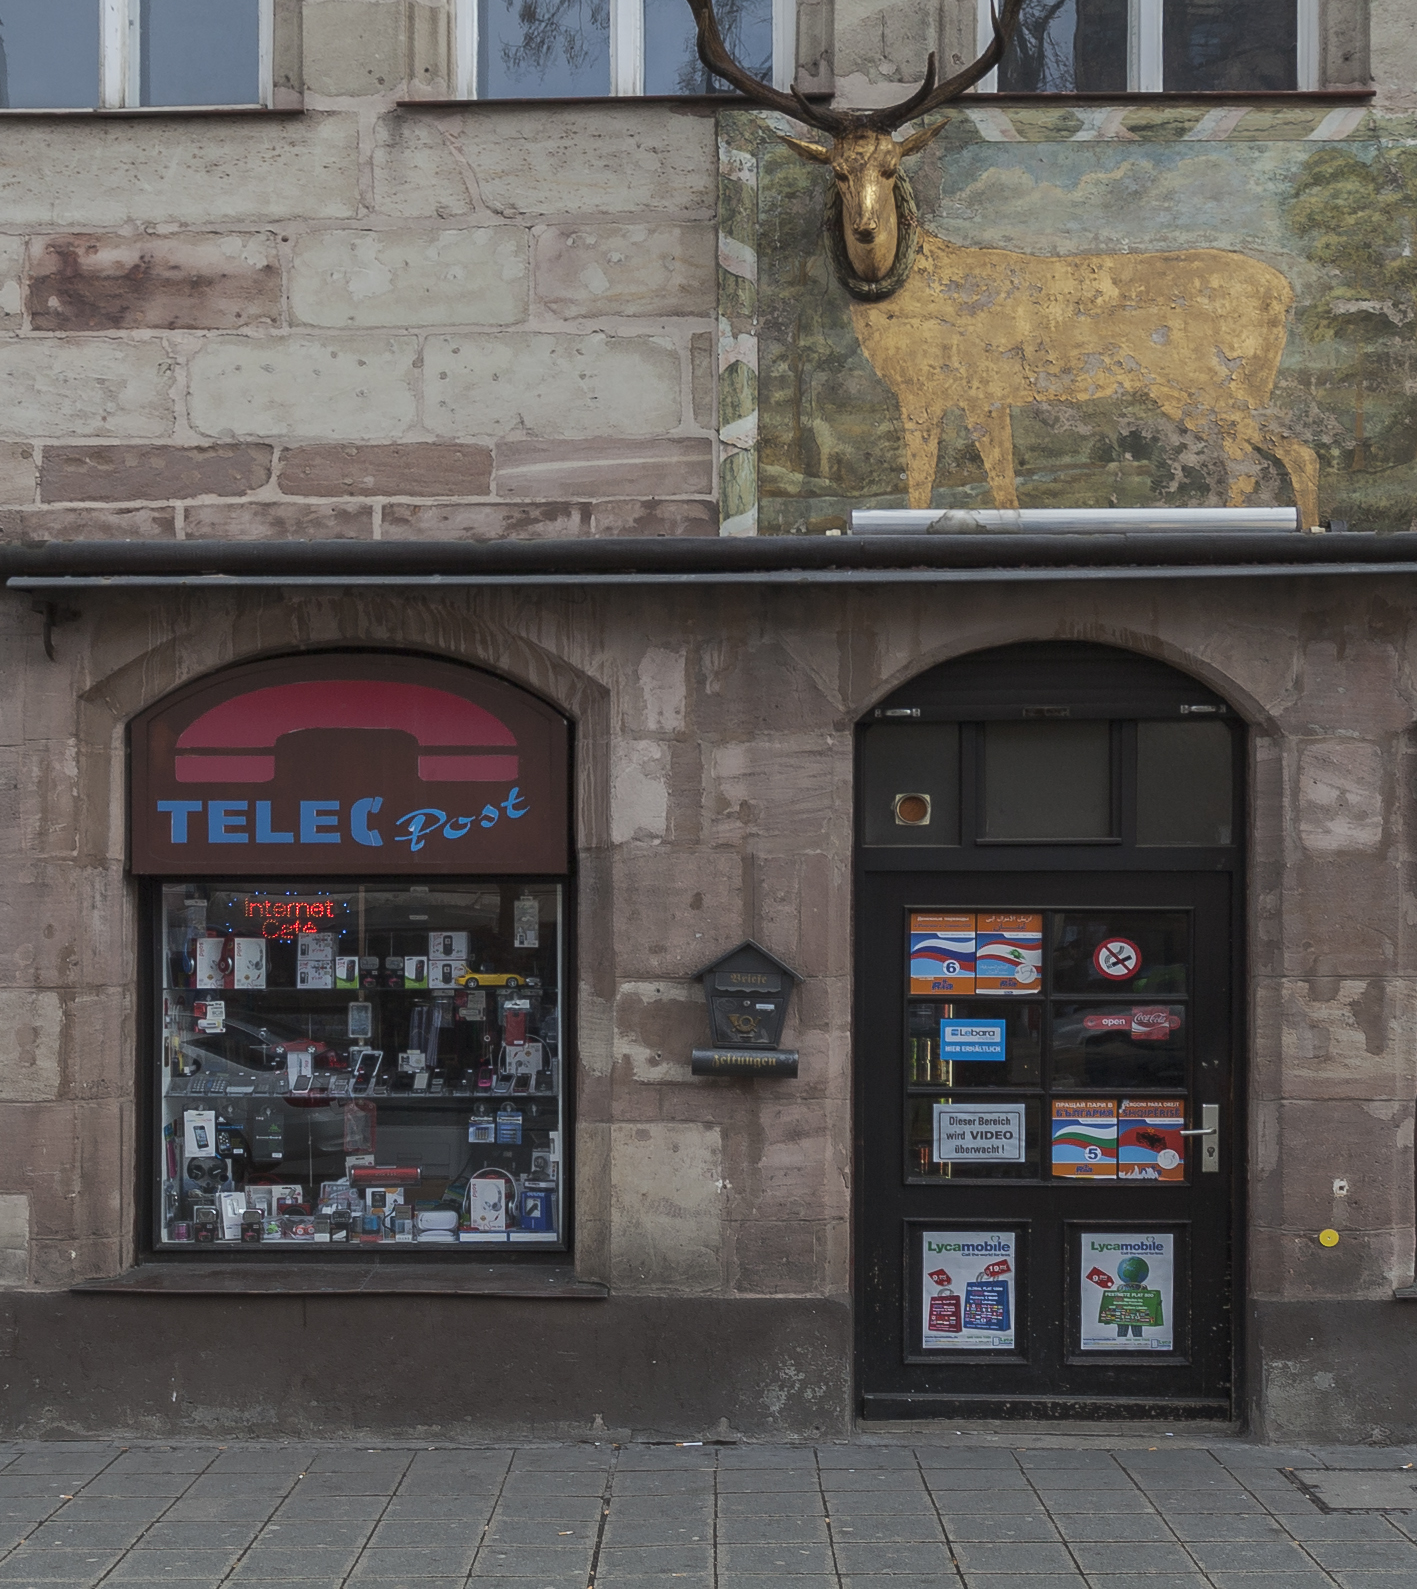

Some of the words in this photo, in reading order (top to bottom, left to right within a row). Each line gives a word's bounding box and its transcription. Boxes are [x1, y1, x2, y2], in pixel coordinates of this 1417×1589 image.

[394, 786, 531, 852] Post
[243, 897, 335, 918] Internet
[946, 961, 957, 974] 6
[730, 972, 768, 985] Briefe
[1102, 1018, 1126, 1027] open
[959, 1028, 995, 1037] Lebara
[712, 1053, 777, 1069] Zeitungen
[948, 1116, 976, 1126] Dieser
[978, 1116, 1011, 1126] Bereich
[946, 1130, 966, 1140] wird
[970, 1130, 1014, 1140] VIDEO
[954, 1144, 1000, 1154] überwacht
[1087, 1148, 1099, 1159] 5
[927, 1240, 1011, 1253] Lycamobile
[1091, 1241, 1164, 1253] Lycamobile
